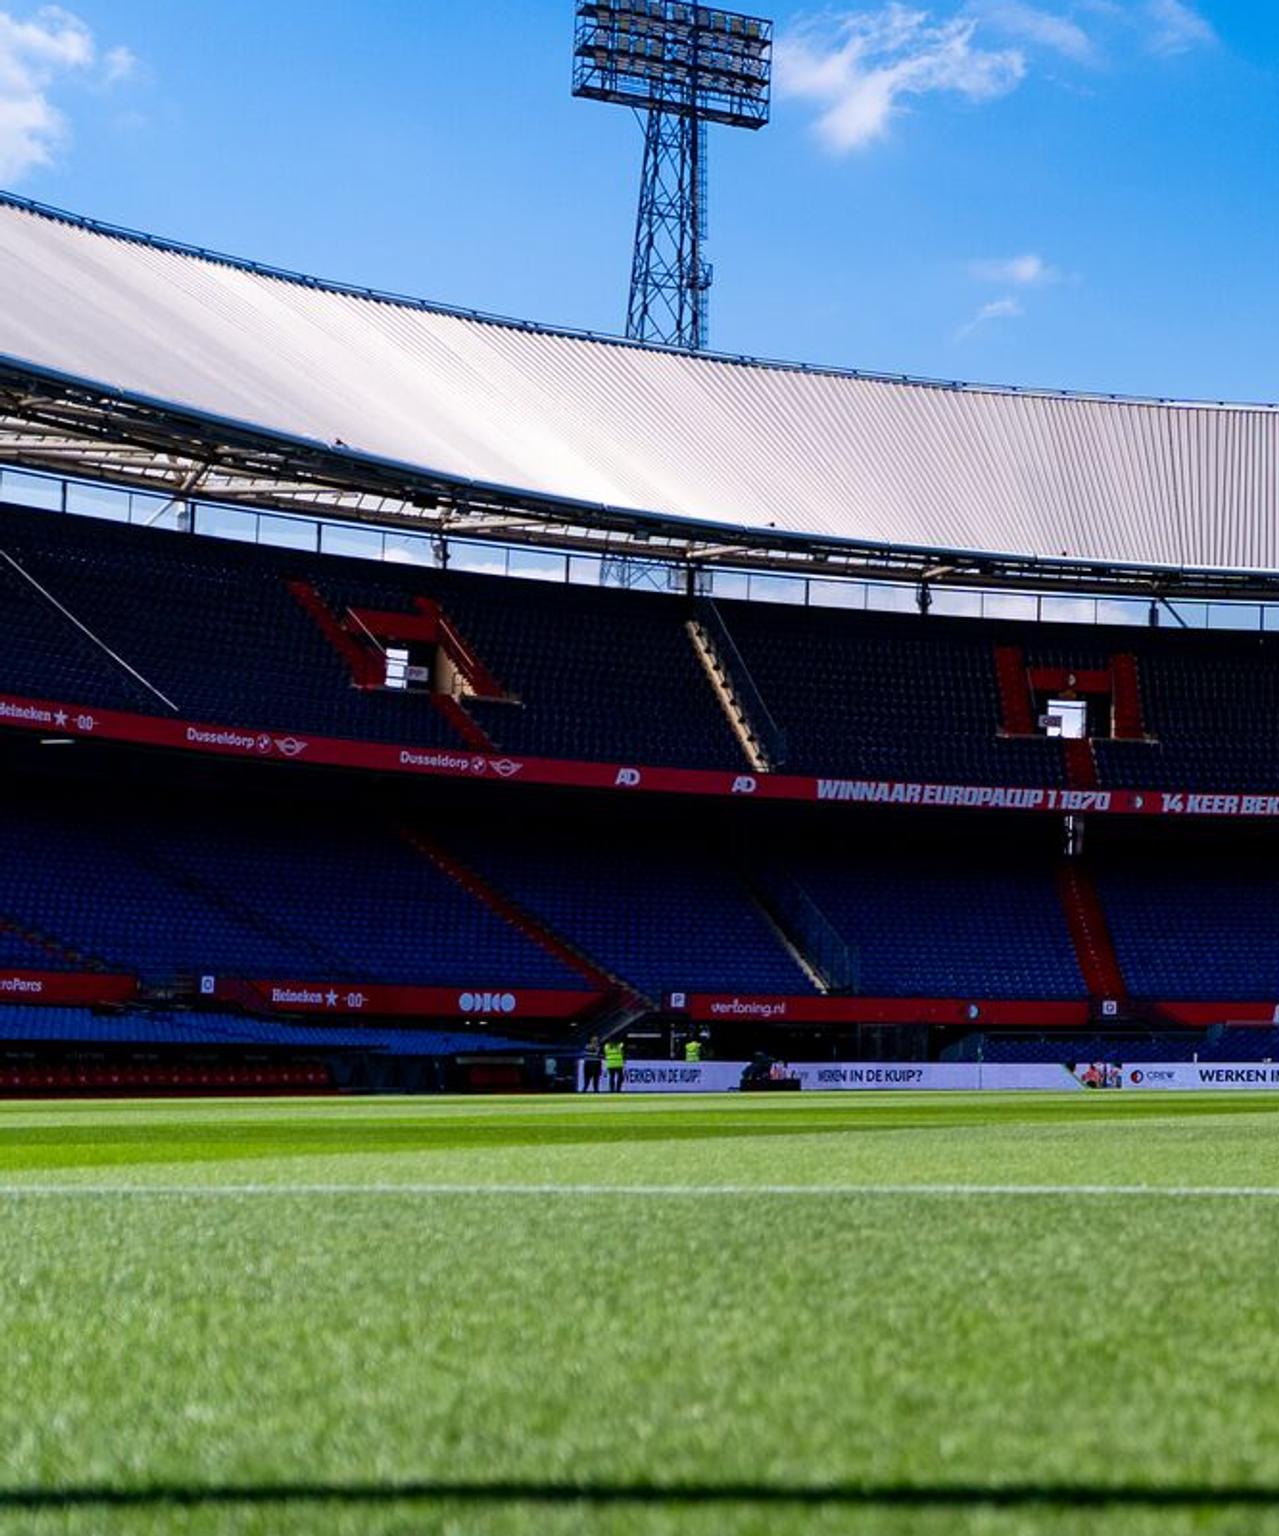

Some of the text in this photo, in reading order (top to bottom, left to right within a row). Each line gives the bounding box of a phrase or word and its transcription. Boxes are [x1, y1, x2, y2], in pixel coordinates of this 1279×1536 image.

[186, 727, 255, 750] Dusseldorp
[399, 750, 469, 771] Dusseldorp
[615, 768, 641, 786] AD
[731, 776, 757, 793] AD
[817, 779, 922, 803] WINNAAR
[919, 785, 1044, 809] EUROPACUP
[1059, 790, 1111, 811] 1970
[1161, 794, 1184, 812] 14
[1186, 794, 1239, 814] KEER
[272, 988, 323, 1004] Heineken
[849, 1070, 863, 1083] IN
[866, 1070, 883, 1083] DE
[885, 1070, 922, 1083] KUIP?
[1199, 1069, 1266, 1082] WERKEN
